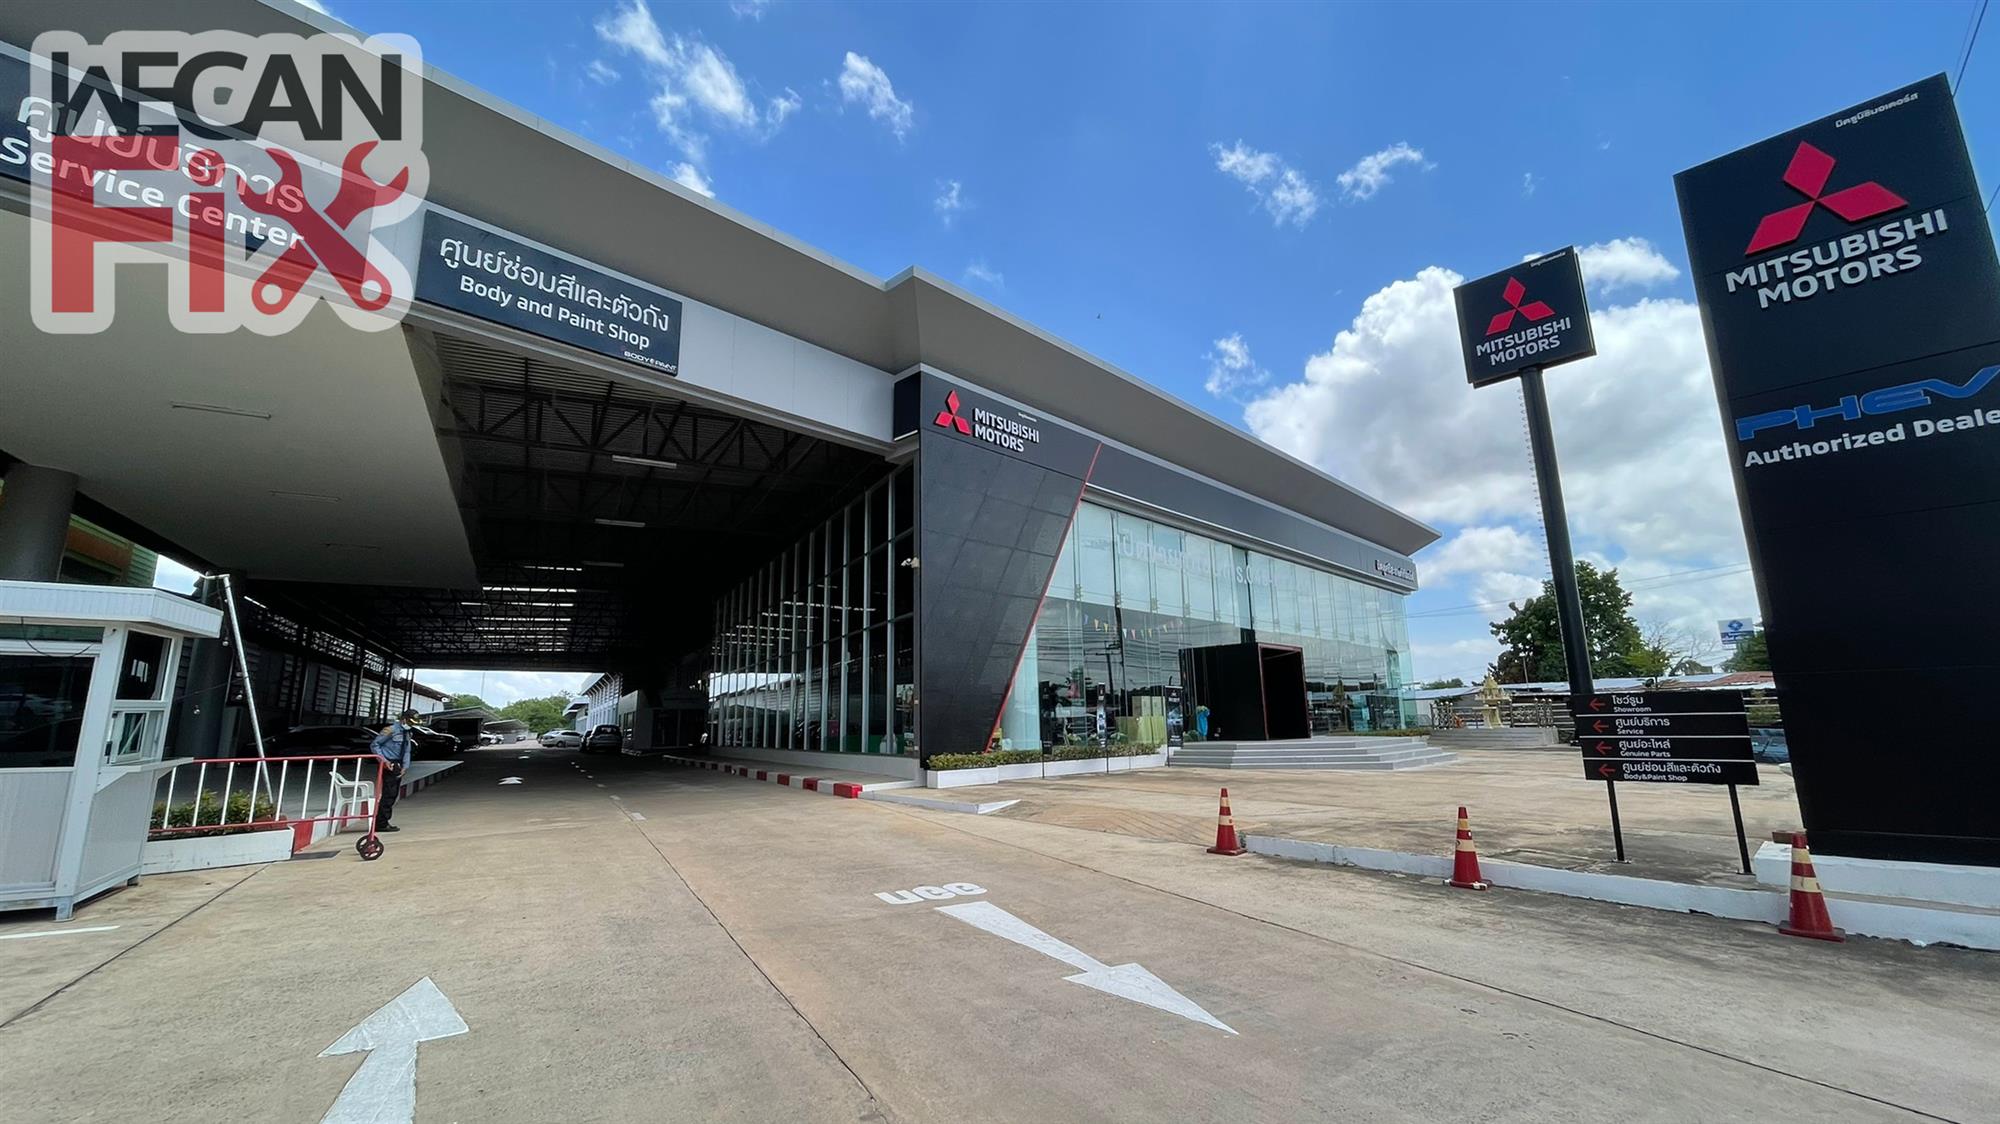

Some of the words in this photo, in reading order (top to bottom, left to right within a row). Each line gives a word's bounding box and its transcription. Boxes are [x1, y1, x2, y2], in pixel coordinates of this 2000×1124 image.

[0, 136, 165, 208] Service
[177, 192, 306, 250] Center
[1725, 208, 1949, 293] MITSUBISHI
[439, 237, 670, 333] ศูนย์ซ่อมสีและตัวถัง
[1757, 244, 1923, 310] MOTORS
[459, 274, 513, 307] Body
[516, 296, 553, 319] and
[557, 306, 605, 336] Paint
[608, 324, 651, 351] Shop
[1475, 317, 1572, 357] MITSUBISHI
[1489, 335, 1561, 366] MOTORS
[1735, 364, 2000, 442] PHEV
[973, 407, 1040, 444] MITSUBISHI
[973, 423, 1025, 453] MOTORS
[1744, 423, 1907, 468] Authorized
[1611, 695, 1644, 707] โชว์รูม
[1615, 717, 1671, 729] ศูนย์บริการ
[1618, 739, 1671, 751] ศูนย์อะไหล่
[1650, 750, 1671, 758] Parts
[1622, 761, 1722, 774] ศูนย์ซ่อมสีและตัวถัง
